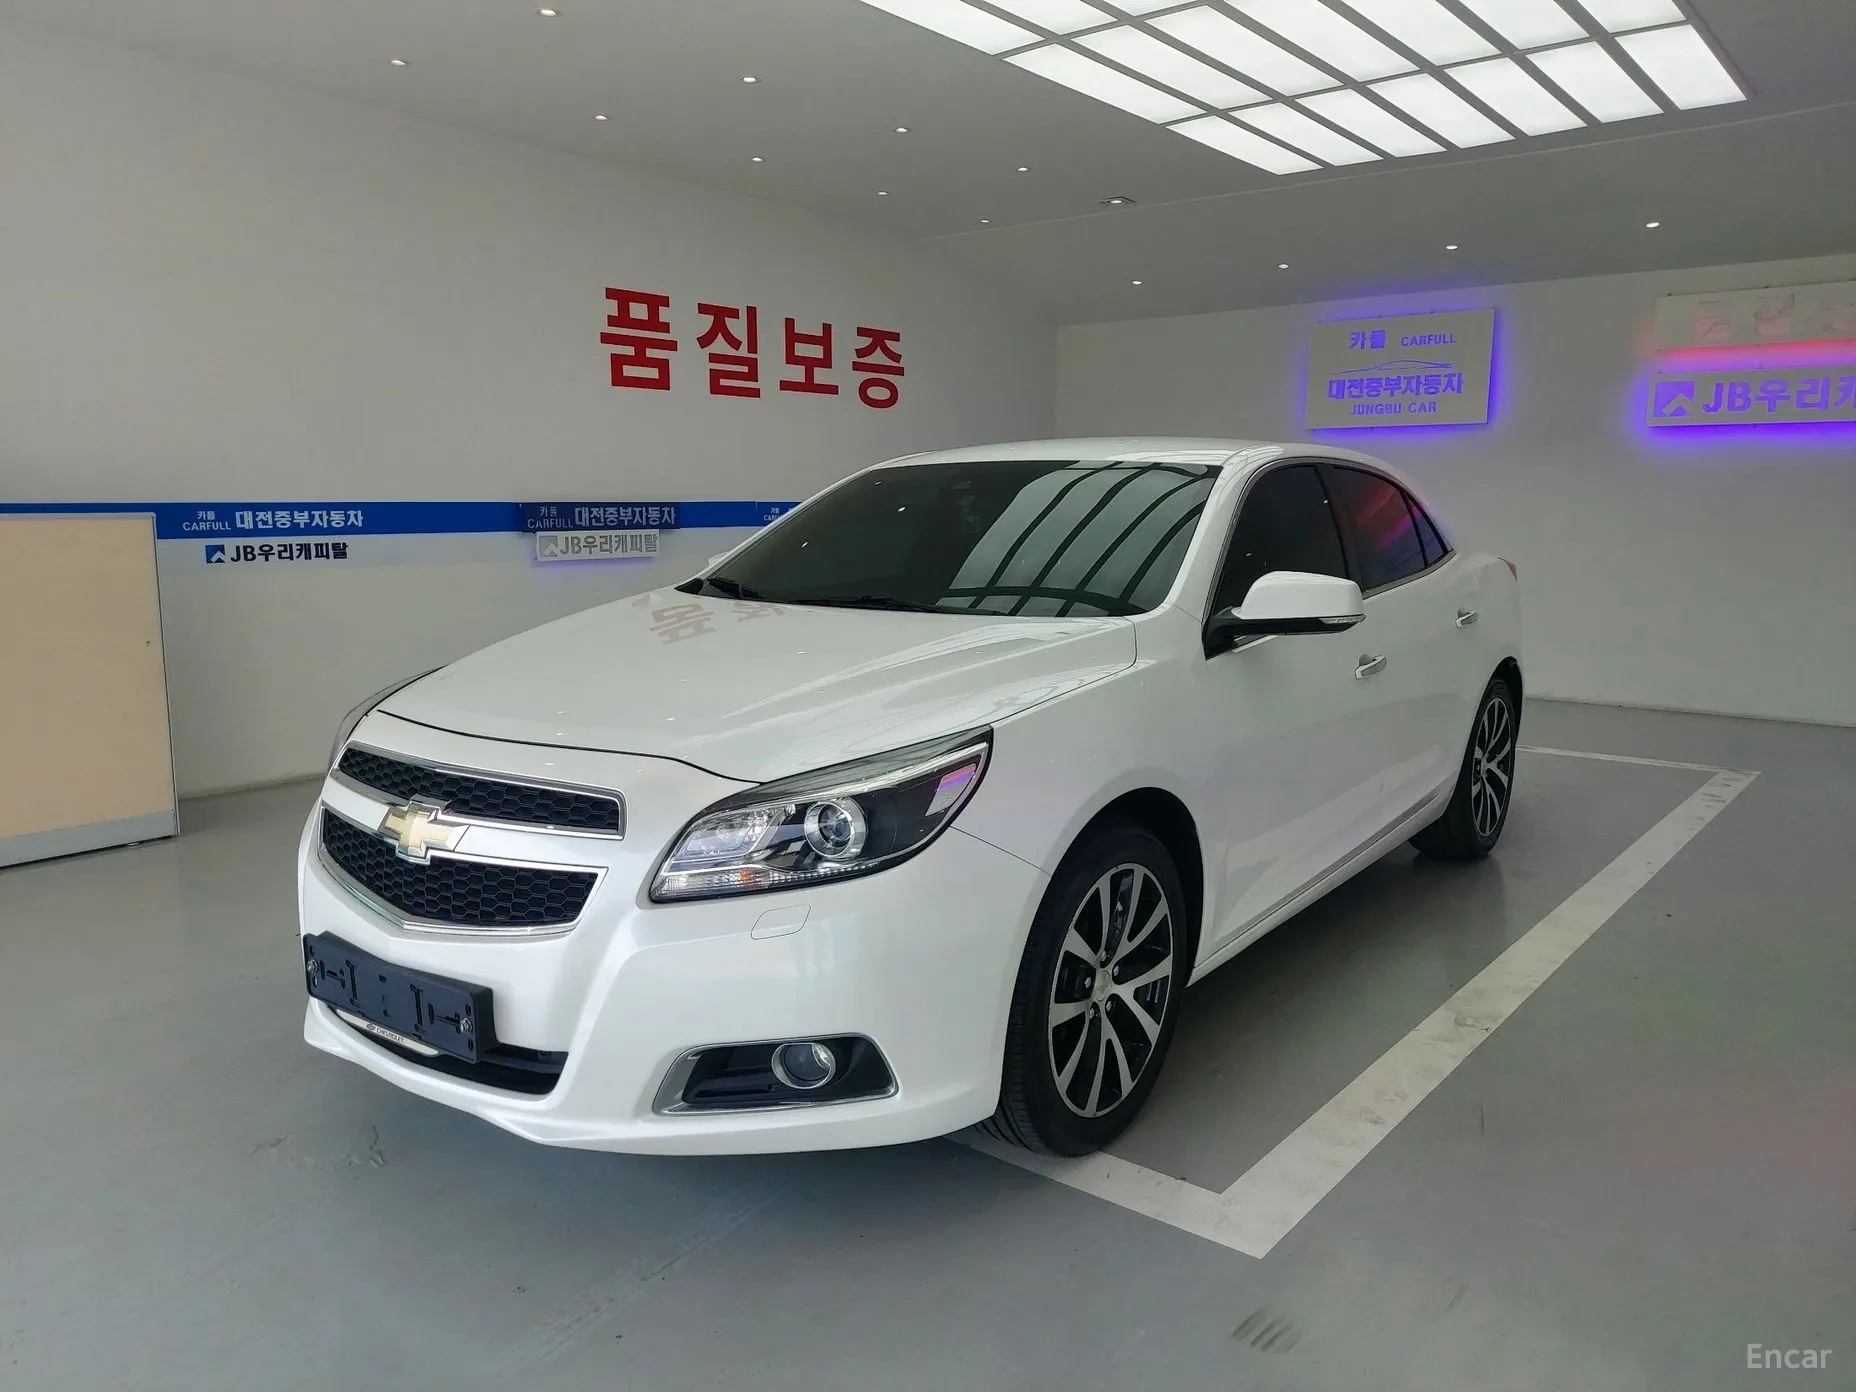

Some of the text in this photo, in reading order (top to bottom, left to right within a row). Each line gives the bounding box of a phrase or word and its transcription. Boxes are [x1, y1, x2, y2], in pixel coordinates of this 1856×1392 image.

[600, 287, 905, 409] 품질보증
[1400, 333, 1457, 347] CARFULL
[1408, 401, 1437, 414] CAR
[182, 521, 232, 531] CARFULL
[235, 510, 364, 530] 대전중부자동차
[527, 518, 574, 529] CARFULL
[574, 506, 677, 528] 대전중부자동차
[230, 542, 349, 563] JB우리캐피탈
[559, 533, 658, 555] JB우리캐피탈
